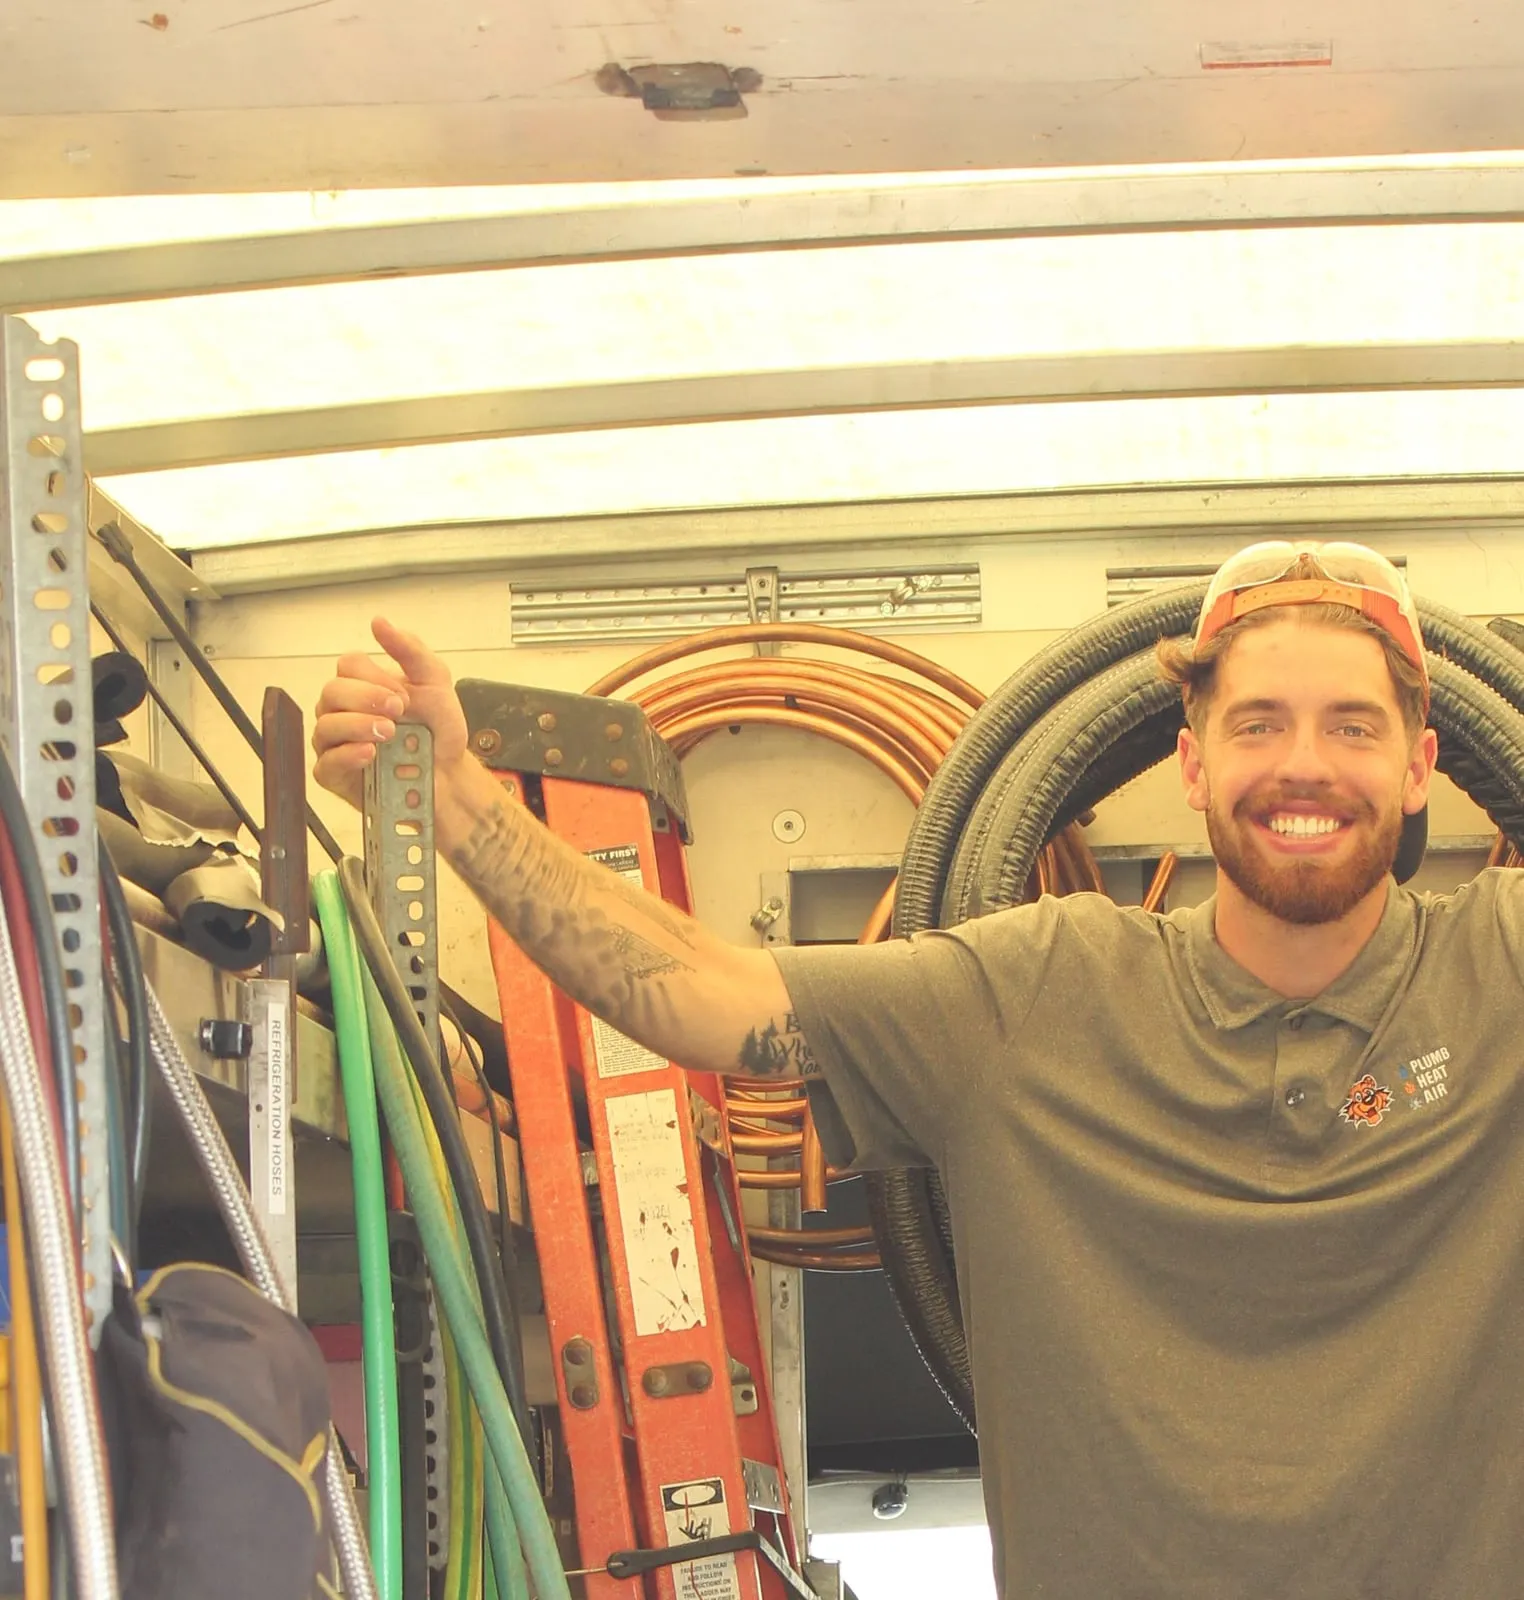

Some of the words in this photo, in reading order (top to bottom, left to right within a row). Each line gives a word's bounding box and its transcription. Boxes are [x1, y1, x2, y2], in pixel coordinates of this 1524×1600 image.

[609, 847, 637, 859] FIRST
[1409, 1046, 1450, 1074] PLUMB
[271, 1019, 282, 1141] REFRIGERATION
[1415, 1064, 1448, 1089] HEAT
[1423, 1082, 1449, 1104] AIR
[271, 1143, 282, 1197] HOSES
